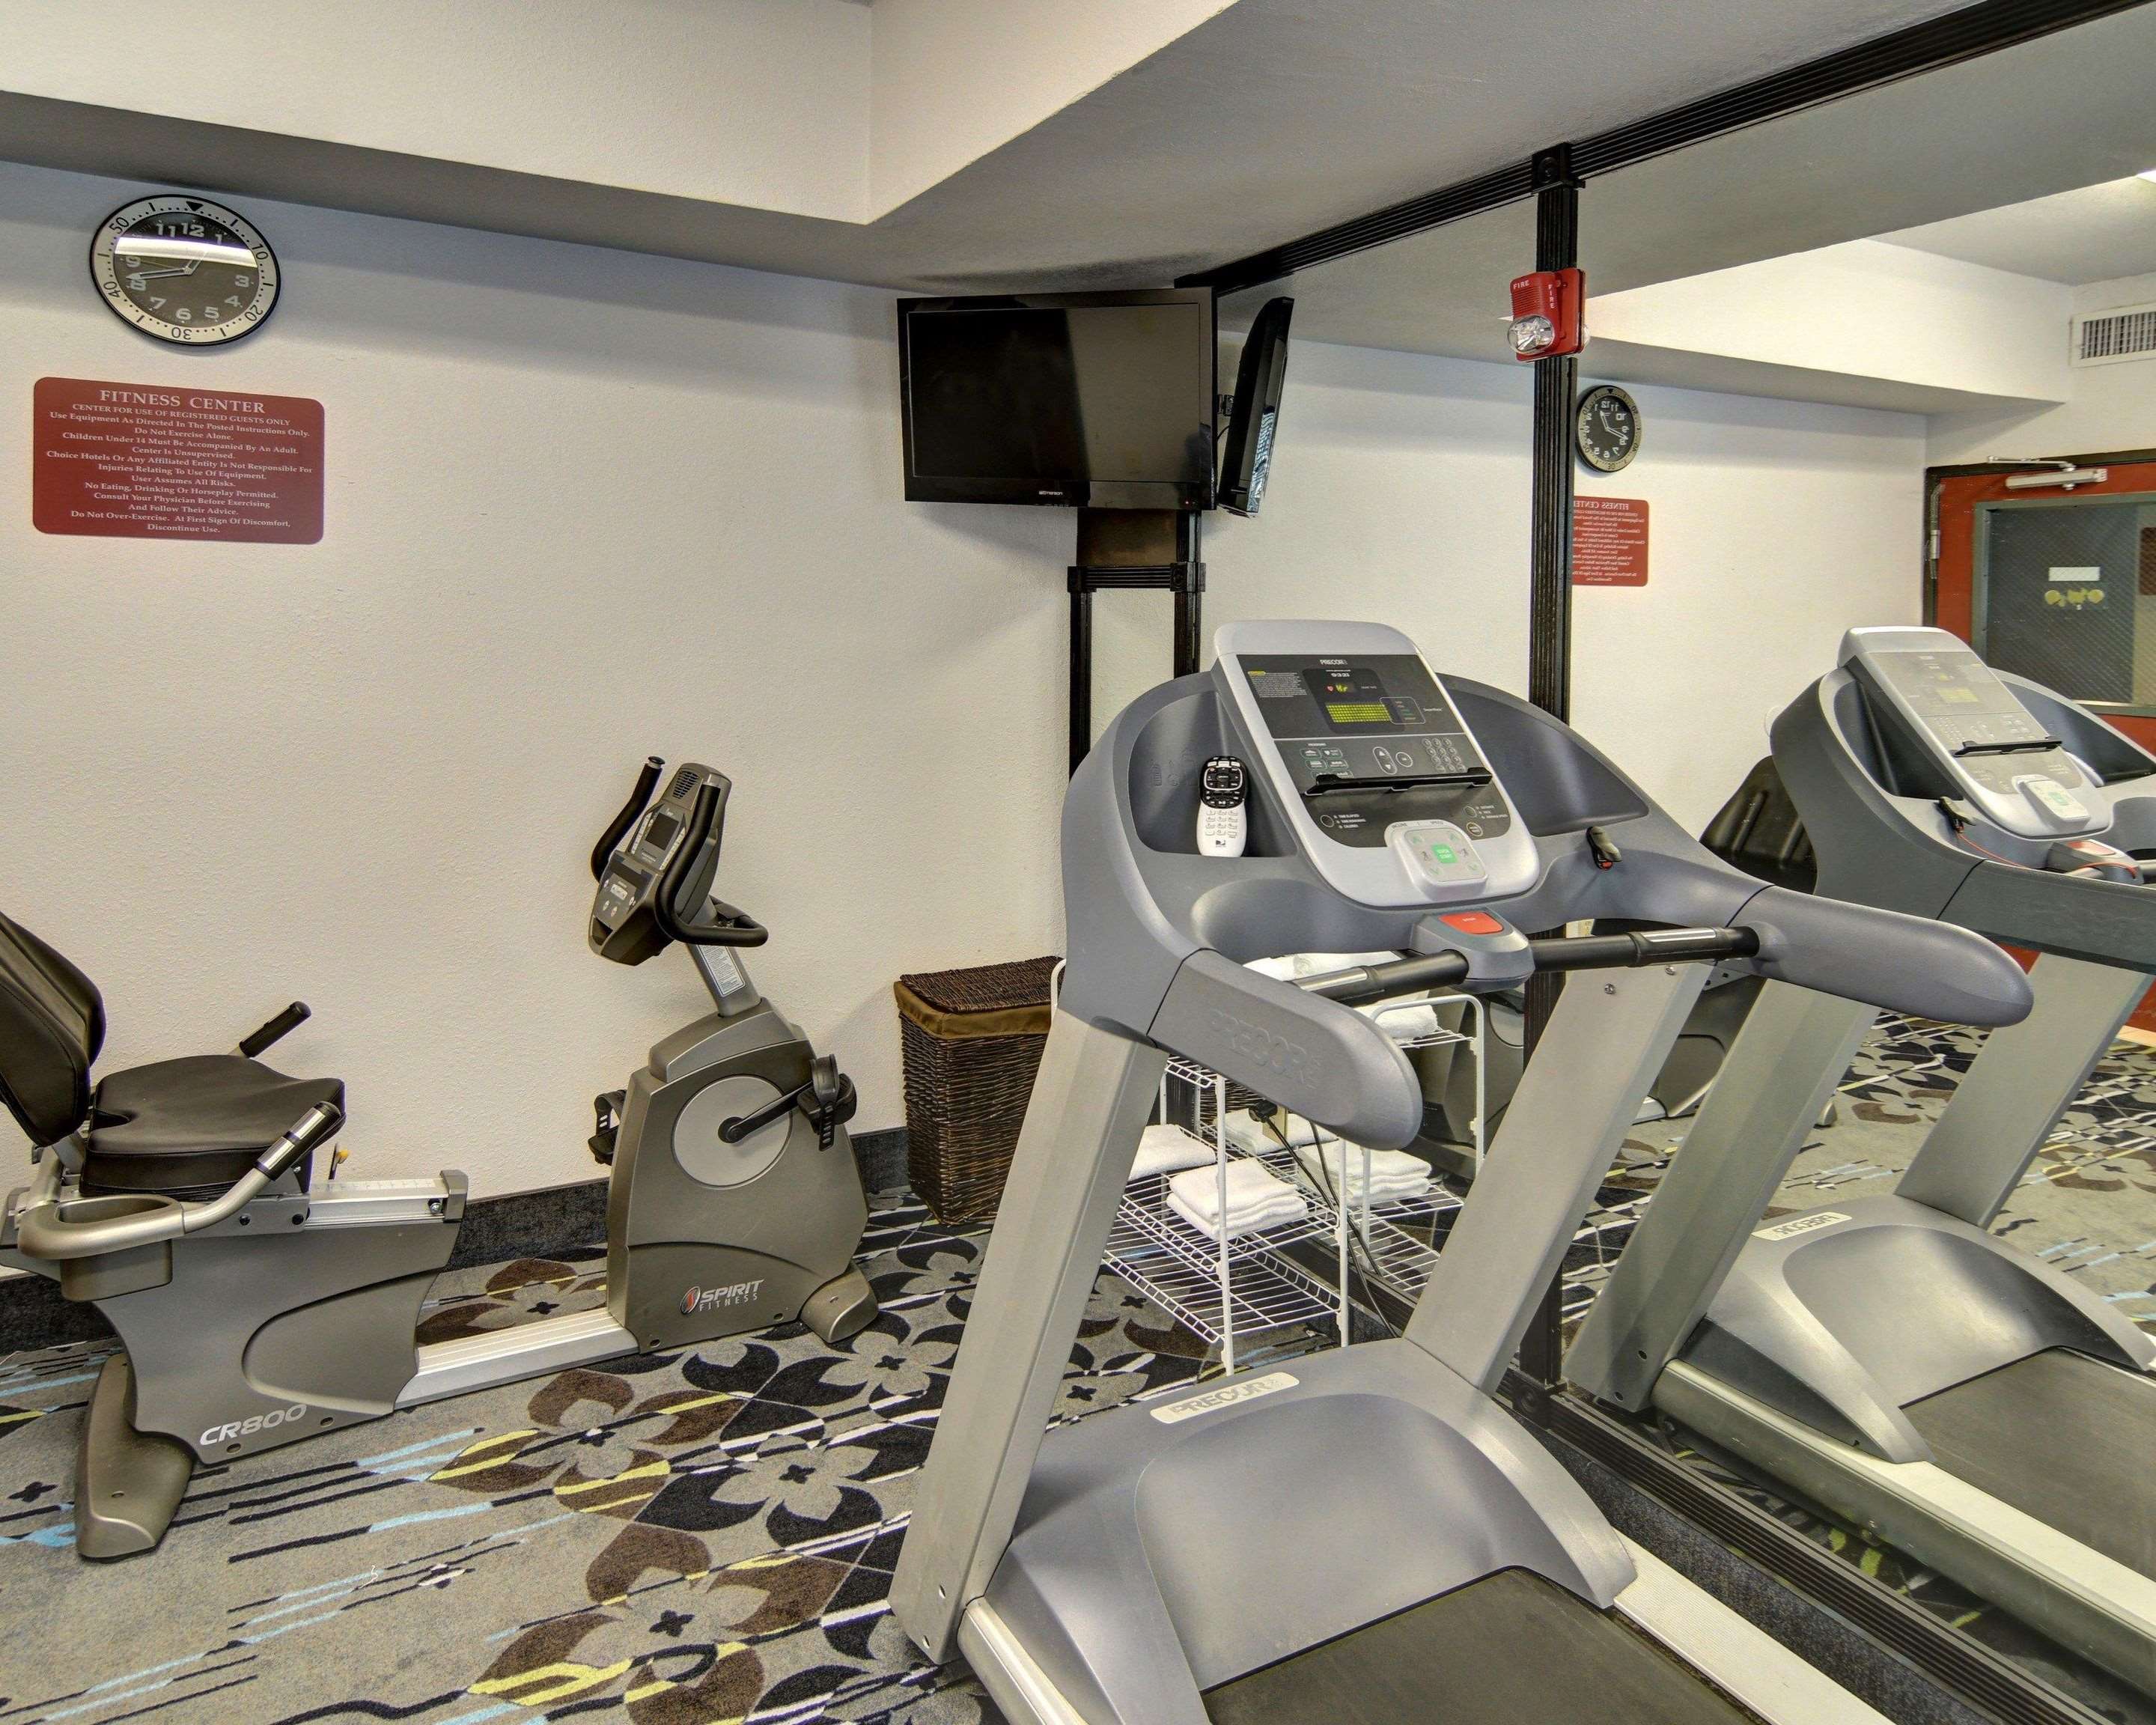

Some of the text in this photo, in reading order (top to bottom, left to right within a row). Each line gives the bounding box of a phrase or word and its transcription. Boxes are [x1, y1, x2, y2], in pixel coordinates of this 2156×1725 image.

[109, 216, 130, 234] 50
[156, 222, 177, 238] 11
[181, 222, 205, 237] 12
[252, 243, 270, 261] 10
[126, 256, 141, 268] 9
[234, 275, 250, 288] 3
[1513, 280, 1530, 290] FIRE
[103, 282, 122, 298] 40
[150, 296, 167, 309] 7
[225, 296, 243, 308] 4
[175, 308, 192, 320] 6
[204, 306, 220, 320] 5
[245, 304, 264, 322] 20
[171, 326, 192, 341] 30
[100, 389, 265, 413] FITNESS CENTER
[73, 404, 111, 413] CENTER
[170, 411, 227, 421] REGISTERED
[229, 416, 264, 424] GUESTS
[70, 413, 119, 423] Equipment
[136, 418, 174, 427] Directed
[189, 421, 204, 429] The
[207, 423, 234, 431] Posted
[237, 425, 285, 435] Instructions
[287, 428, 311, 438] Only.
[63, 432, 103, 441] Children
[106, 434, 133, 443] Under
[148, 438, 171, 446] Must
[186, 440, 243, 451] Accompanied
[246, 445, 256, 453] By
[272, 446, 299, 454] Adult.
[168, 430, 204, 439] Exercise
[207, 432, 234, 440] Alone.
[132, 446, 160, 454] Center
[174, 449, 235, 460] Unsupervised.
[46, 451, 79, 459] Choice
[81, 452, 110, 461] Hotels
[127, 456, 144, 464] Any
[147, 457, 189, 466] Affiliated
[192, 460, 218, 468] Entity
[248, 463, 297, 472] Responsible
[98, 463, 133, 472] Injuries
[136, 466, 173, 475] Relating
[219, 471, 267, 480] Equipment.
[154, 477, 192, 485] Assumes
[101, 482, 132, 492] Eating,
[135, 484, 174, 494] Drinking
[191, 487, 234, 498] Horseplay
[237, 490, 278, 499] Permitted.
[94, 492, 270, 508] Consult Your Physician Before Exercising
[150, 505, 179, 513] Follow
[182, 506, 204, 514] Their
[207, 507, 239, 516] Advice.
[87, 511, 104, 519] Not
[106, 512, 170, 522] Over-Exercise.
[187, 515, 206, 523] First
[208, 517, 228, 525] Sign
[243, 518, 290, 528] Discomfort,
[147, 523, 200, 532] Discontinue
[700, 1278, 765, 1303] SPIRIT
[699, 1292, 758, 1312] FITNESS
[1169, 1379, 1273, 1414] PRECOR
[200, 1404, 307, 1446] CR800
